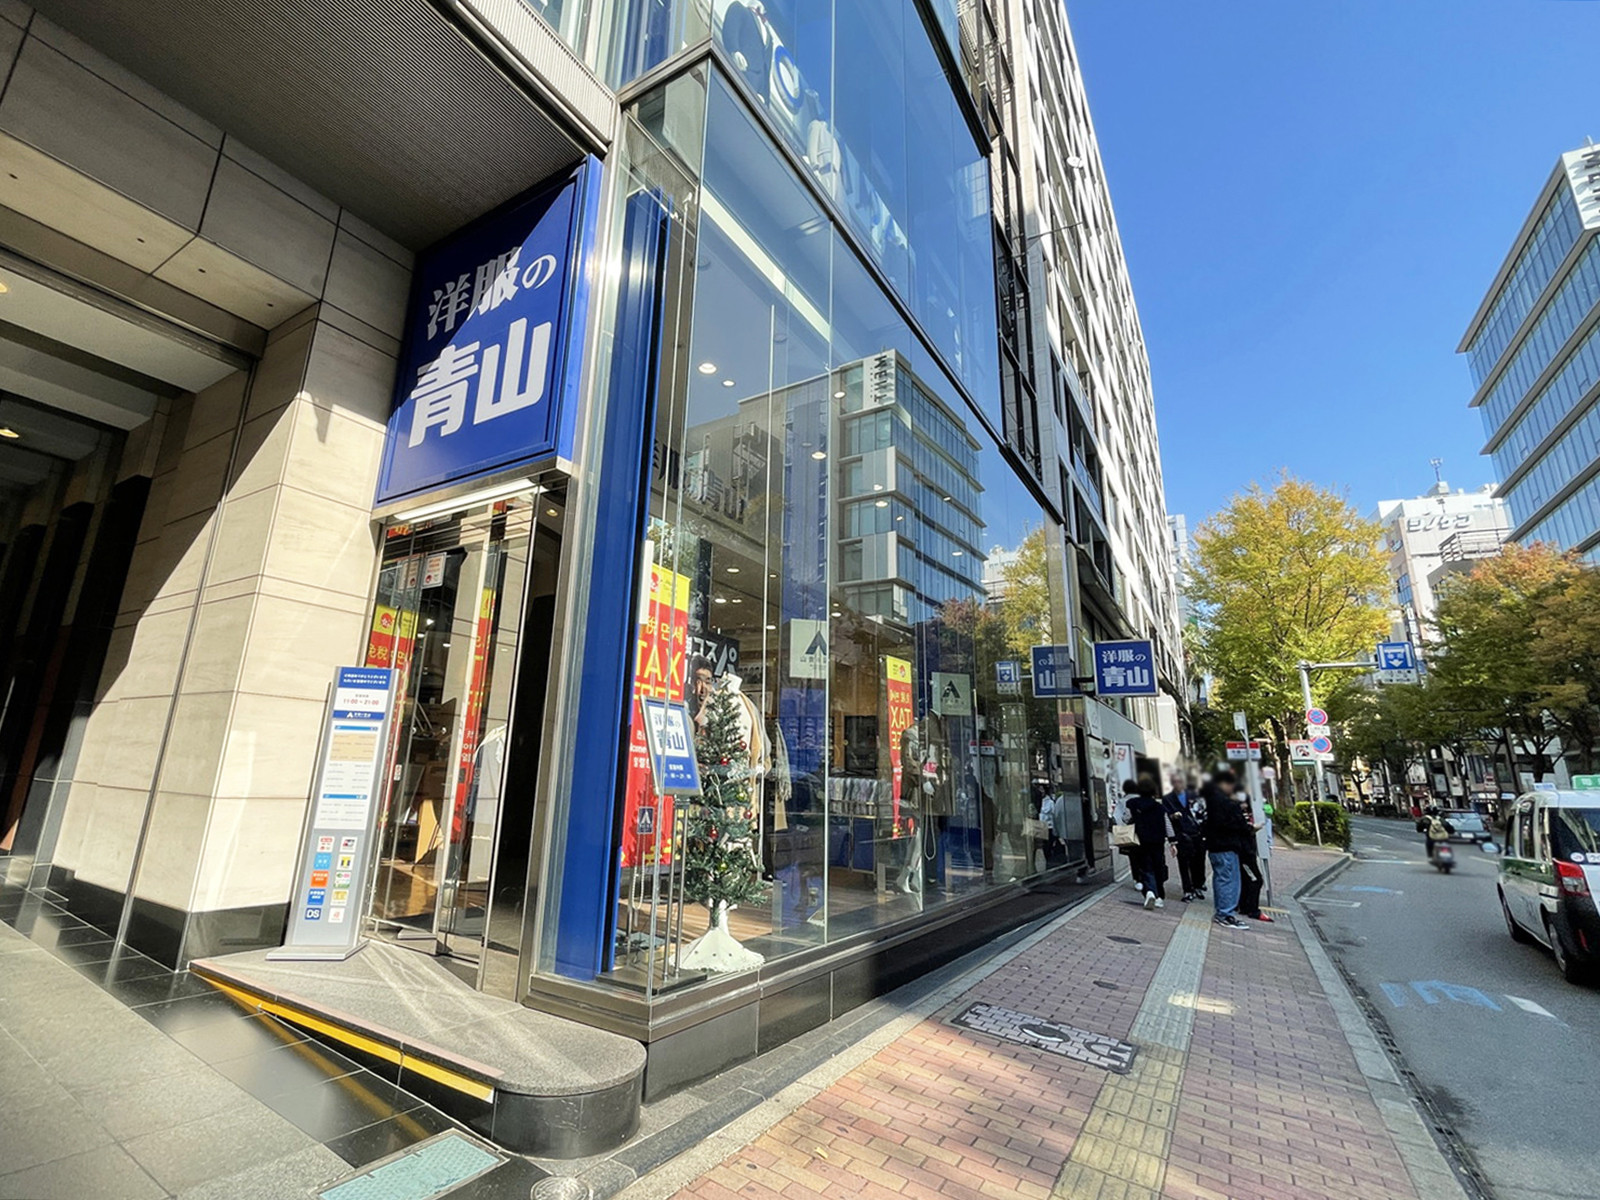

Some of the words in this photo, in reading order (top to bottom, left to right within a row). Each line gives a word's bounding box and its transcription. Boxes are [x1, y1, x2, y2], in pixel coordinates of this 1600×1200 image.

[427, 245, 557, 341] 洋服の
[408, 317, 552, 448] 青山
[635, 639, 682, 687] TAX
[1102, 649, 1147, 664] 洋服の
[1102, 666, 1149, 688] 青山
[306, 909, 320, 918] DS
